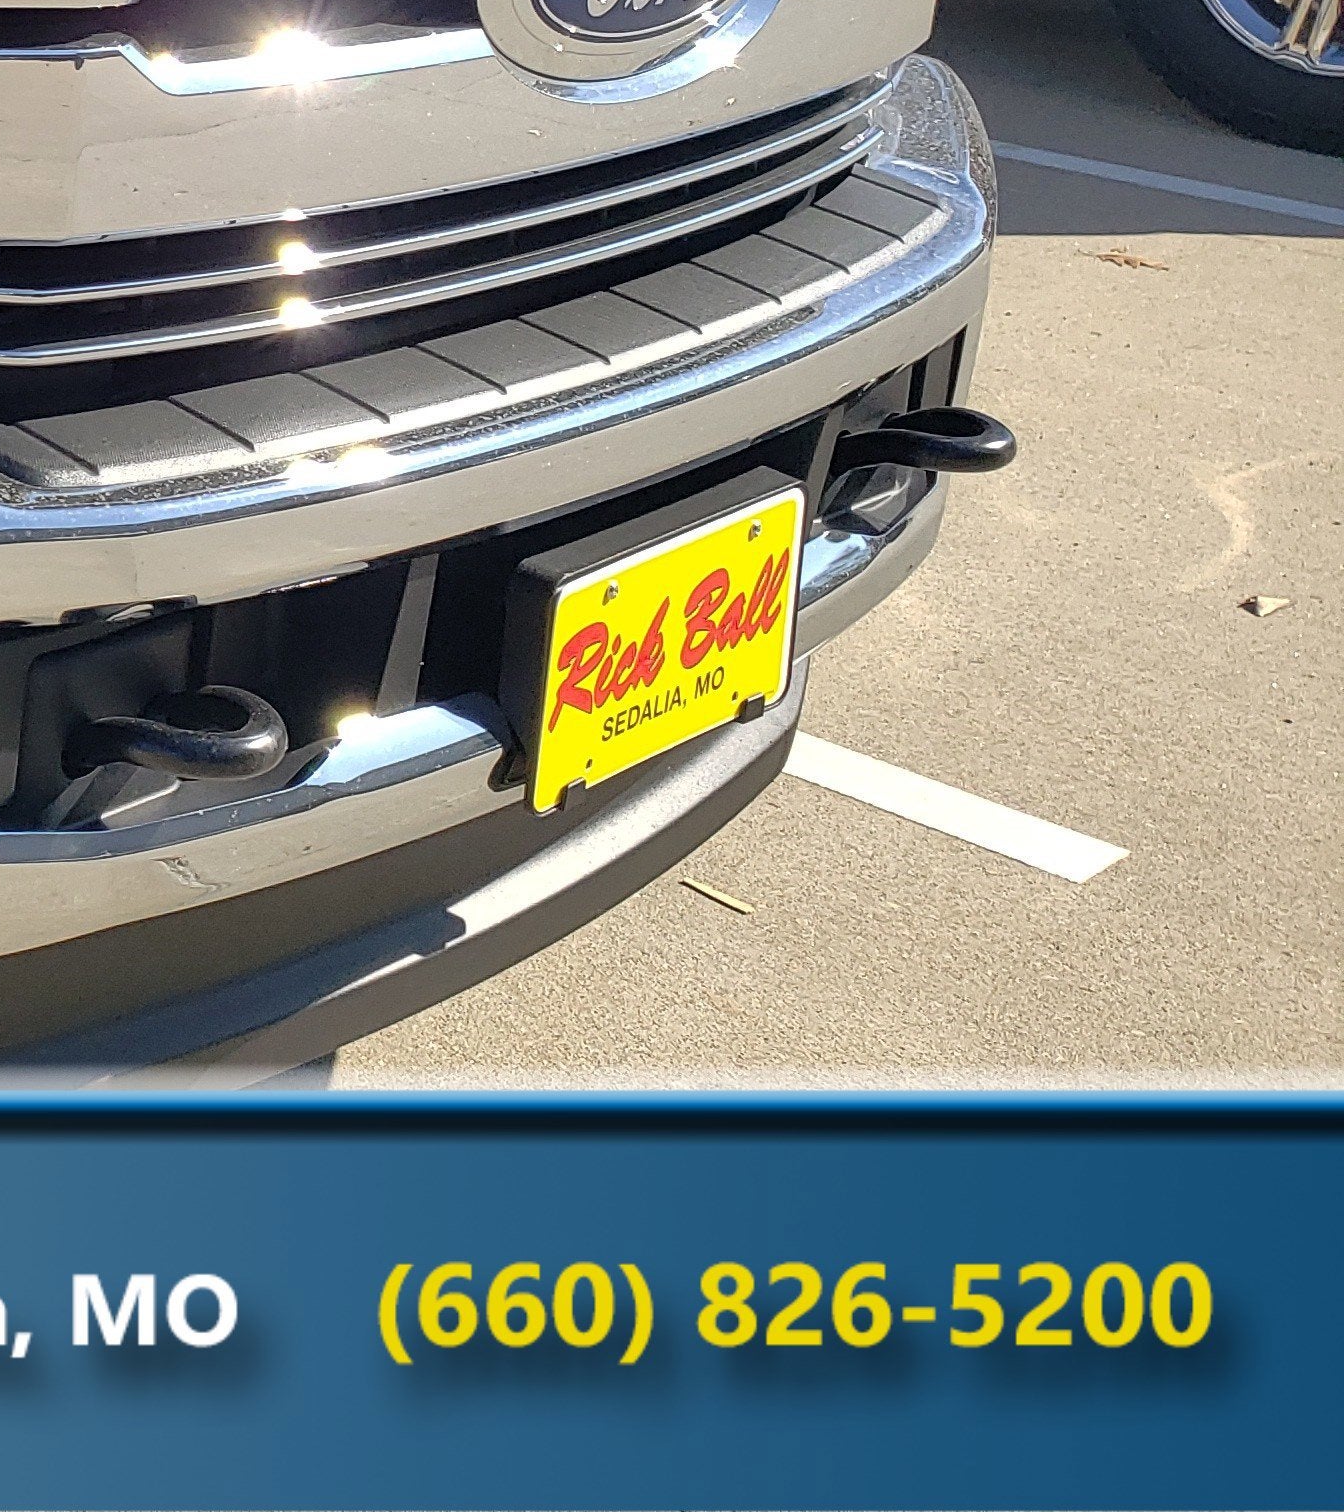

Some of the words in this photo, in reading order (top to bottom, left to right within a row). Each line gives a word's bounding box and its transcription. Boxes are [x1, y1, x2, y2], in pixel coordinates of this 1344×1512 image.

[548, 596, 670, 734] Rick
[680, 547, 790, 669] Ball
[601, 687, 688, 742] SEDALIA,
[694, 666, 725, 701] MO
